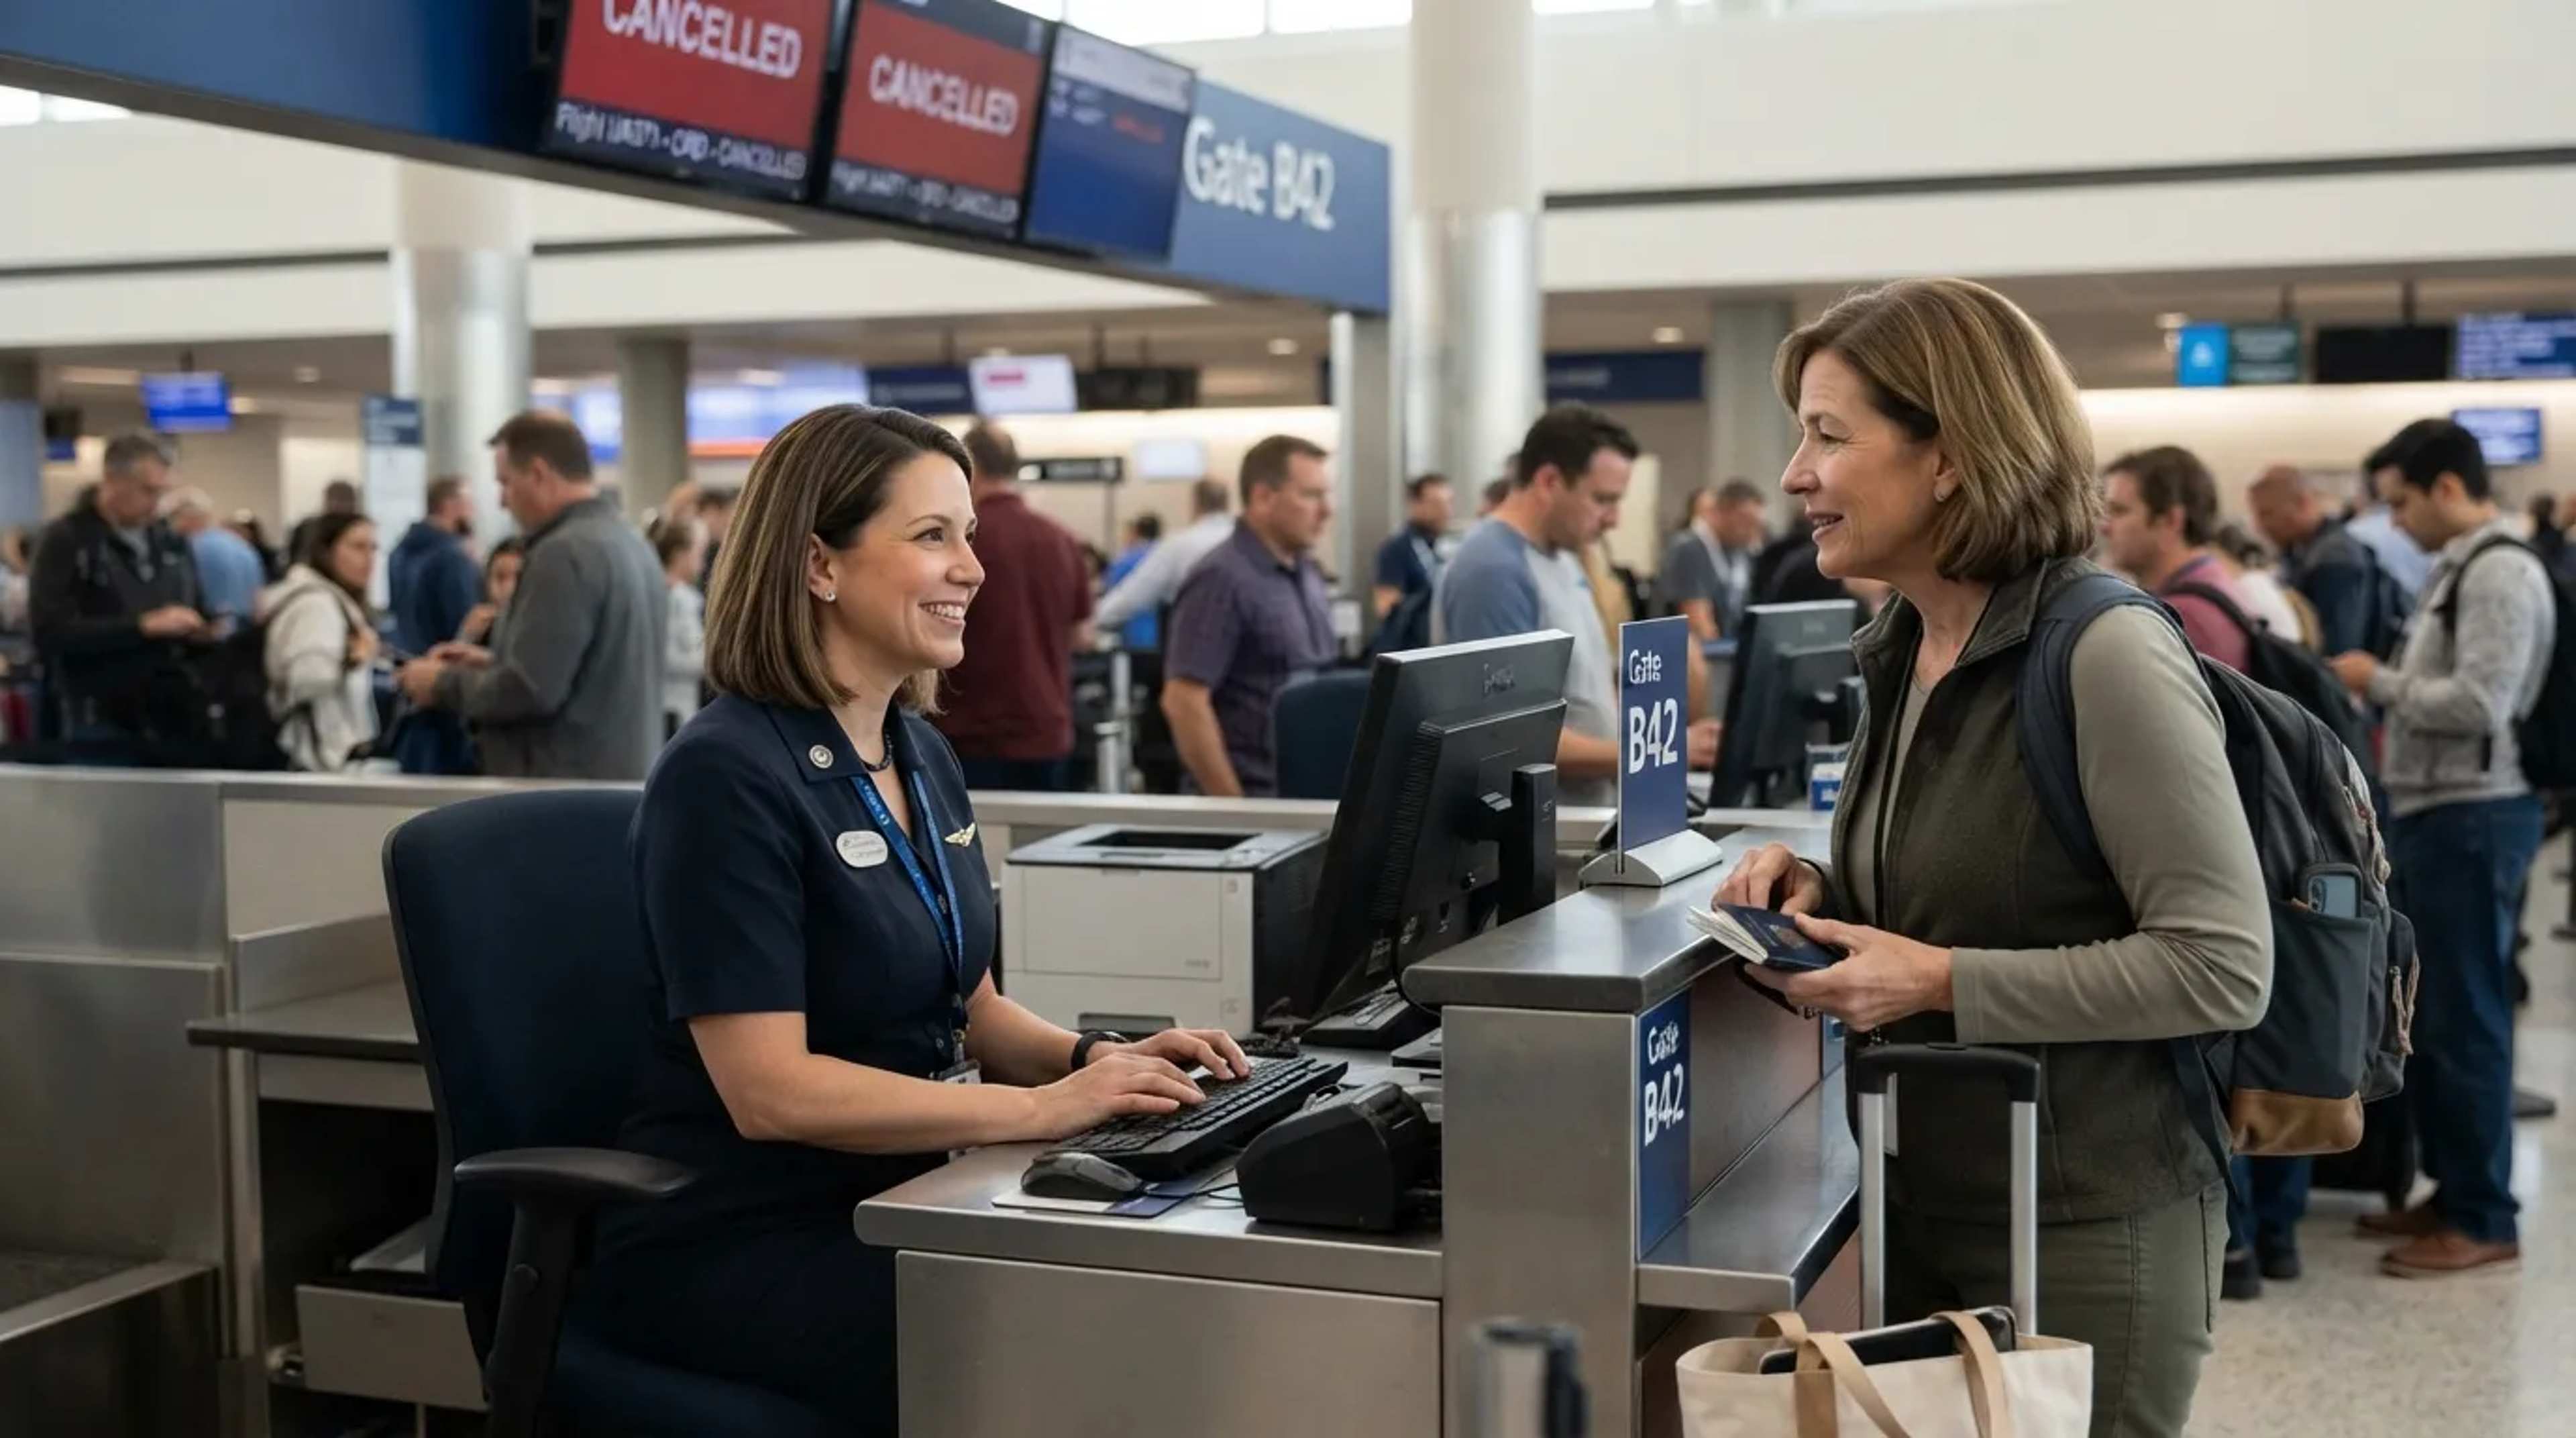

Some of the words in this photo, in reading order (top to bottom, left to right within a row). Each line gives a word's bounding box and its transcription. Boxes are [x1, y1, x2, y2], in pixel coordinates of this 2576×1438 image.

[601, 0, 802, 79] CANCELLED
[869, 55, 1019, 136] CANCELLED
[1183, 115, 1268, 215] Gate
[1273, 142, 1335, 231] B42
[1628, 698, 1678, 774] B42
[1644, 1063, 1685, 1146] B42
